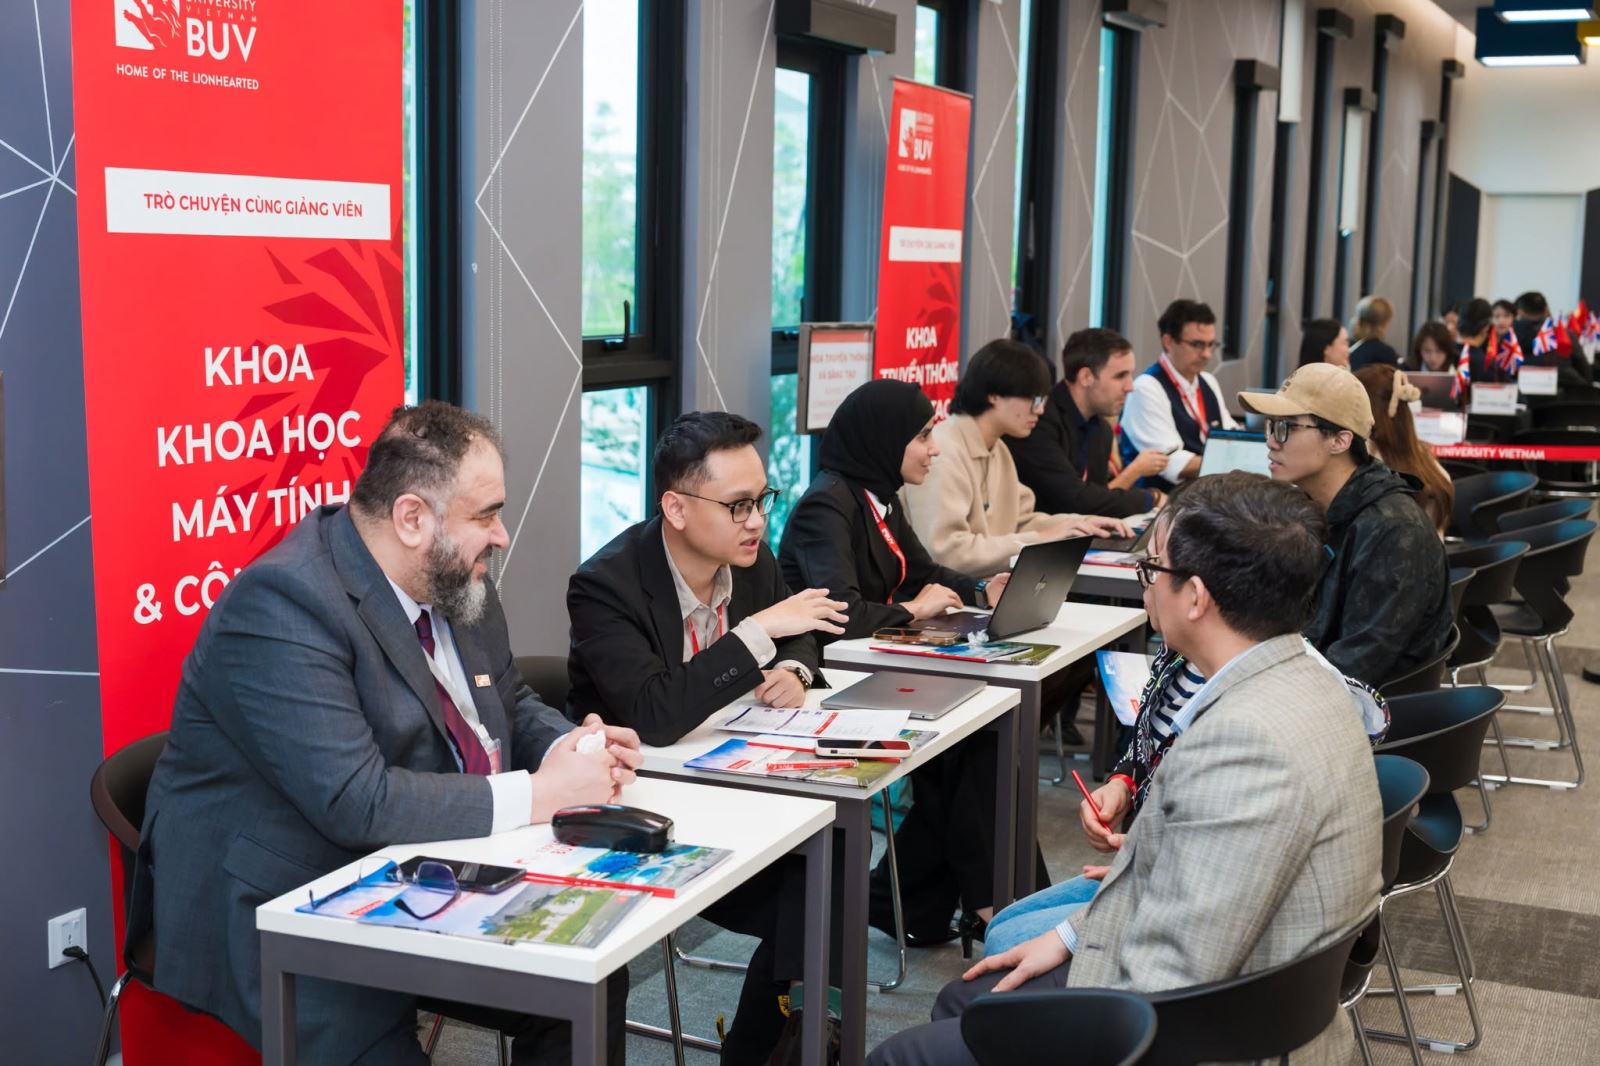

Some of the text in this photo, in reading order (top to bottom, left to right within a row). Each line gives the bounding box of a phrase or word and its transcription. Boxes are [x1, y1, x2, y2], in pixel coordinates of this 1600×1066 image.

[185, 5, 257, 23] VIETNAM
[185, 17, 257, 63] BUV
[116, 63, 260, 90] HOME OF THE LIONHEARTED
[143, 190, 363, 217] TRÒ CHUYỆN CÙNG GIẢNG VIÊN
[906, 326, 938, 350] KHOA
[204, 343, 314, 387] KHOA
[157, 410, 361, 468] KHOA HỌC
[1436, 446, 1497, 458] UNIVERSITY
[1498, 448, 1546, 460] VIETNAM
[171, 485, 258, 543] MÁY
[133, 583, 163, 625] &
